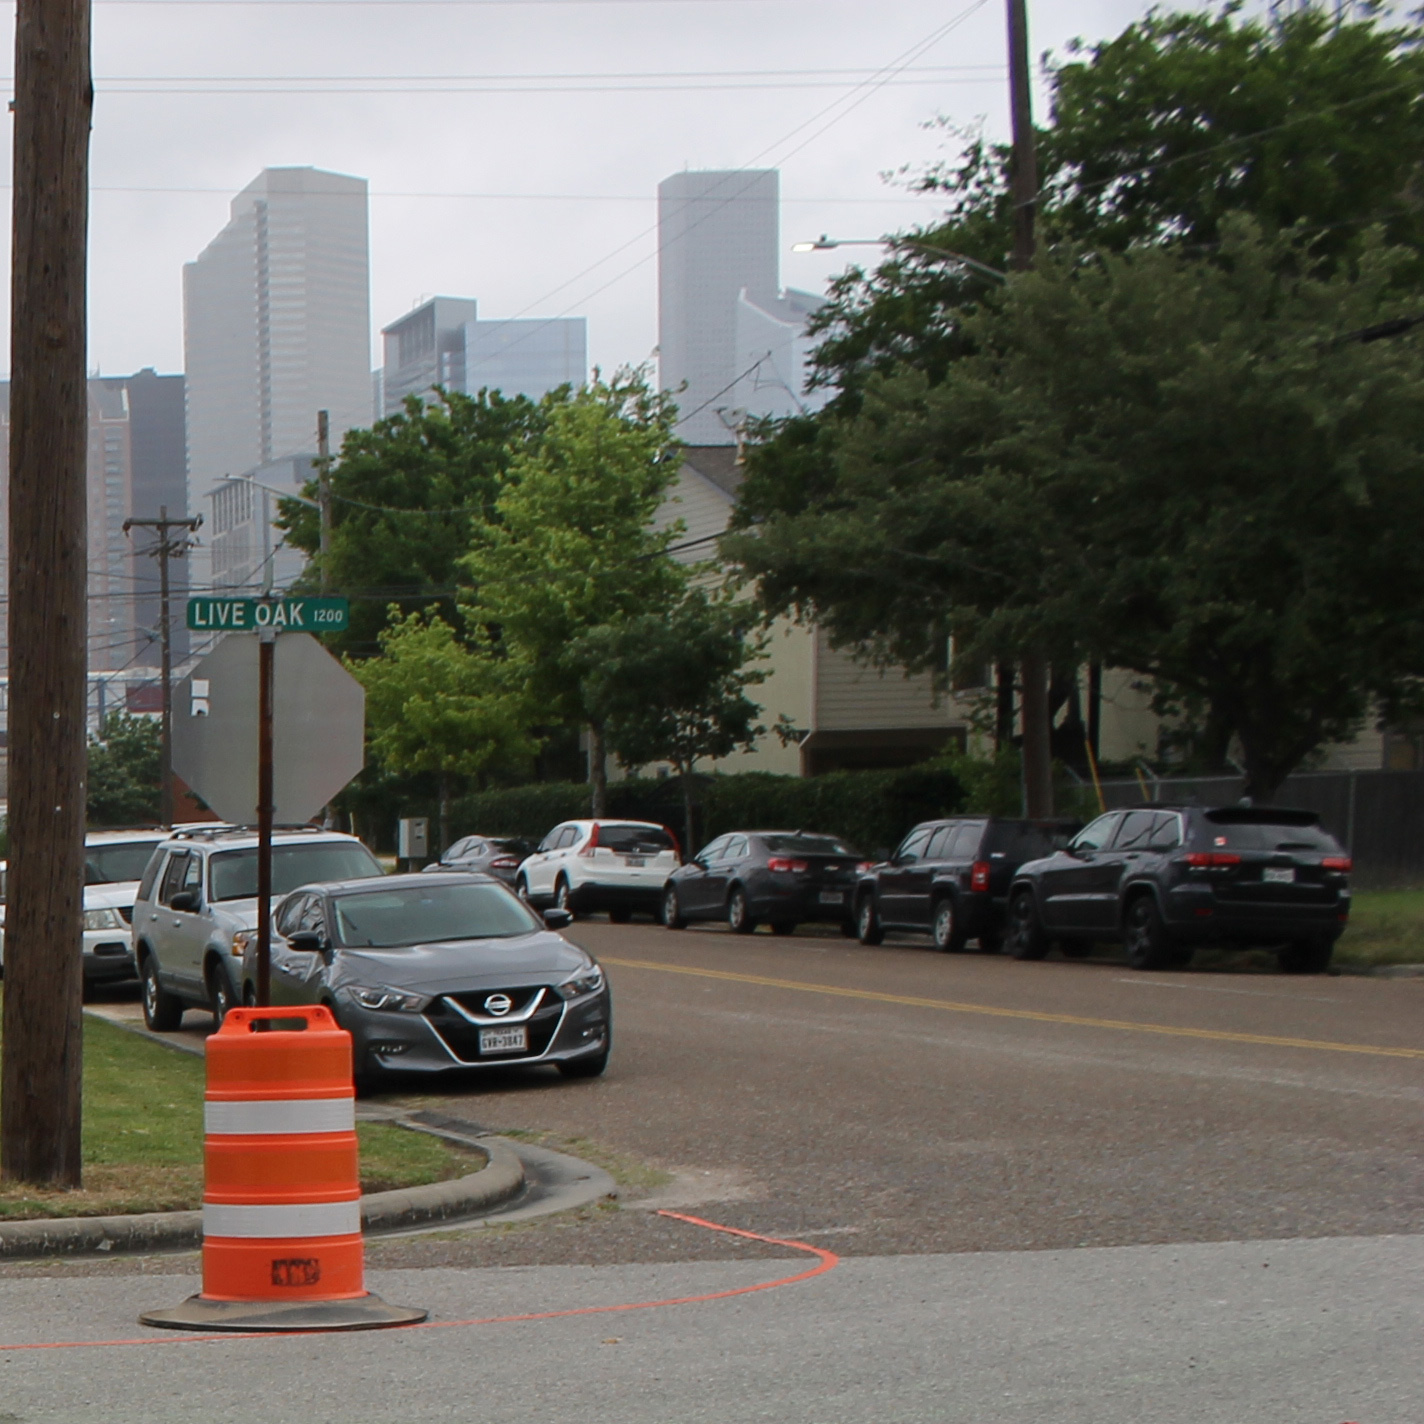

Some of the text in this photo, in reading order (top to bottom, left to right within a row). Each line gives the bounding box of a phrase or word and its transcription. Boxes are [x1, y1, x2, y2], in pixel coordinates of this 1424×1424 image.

[195, 602, 343, 626] LIVE OAK 1200
